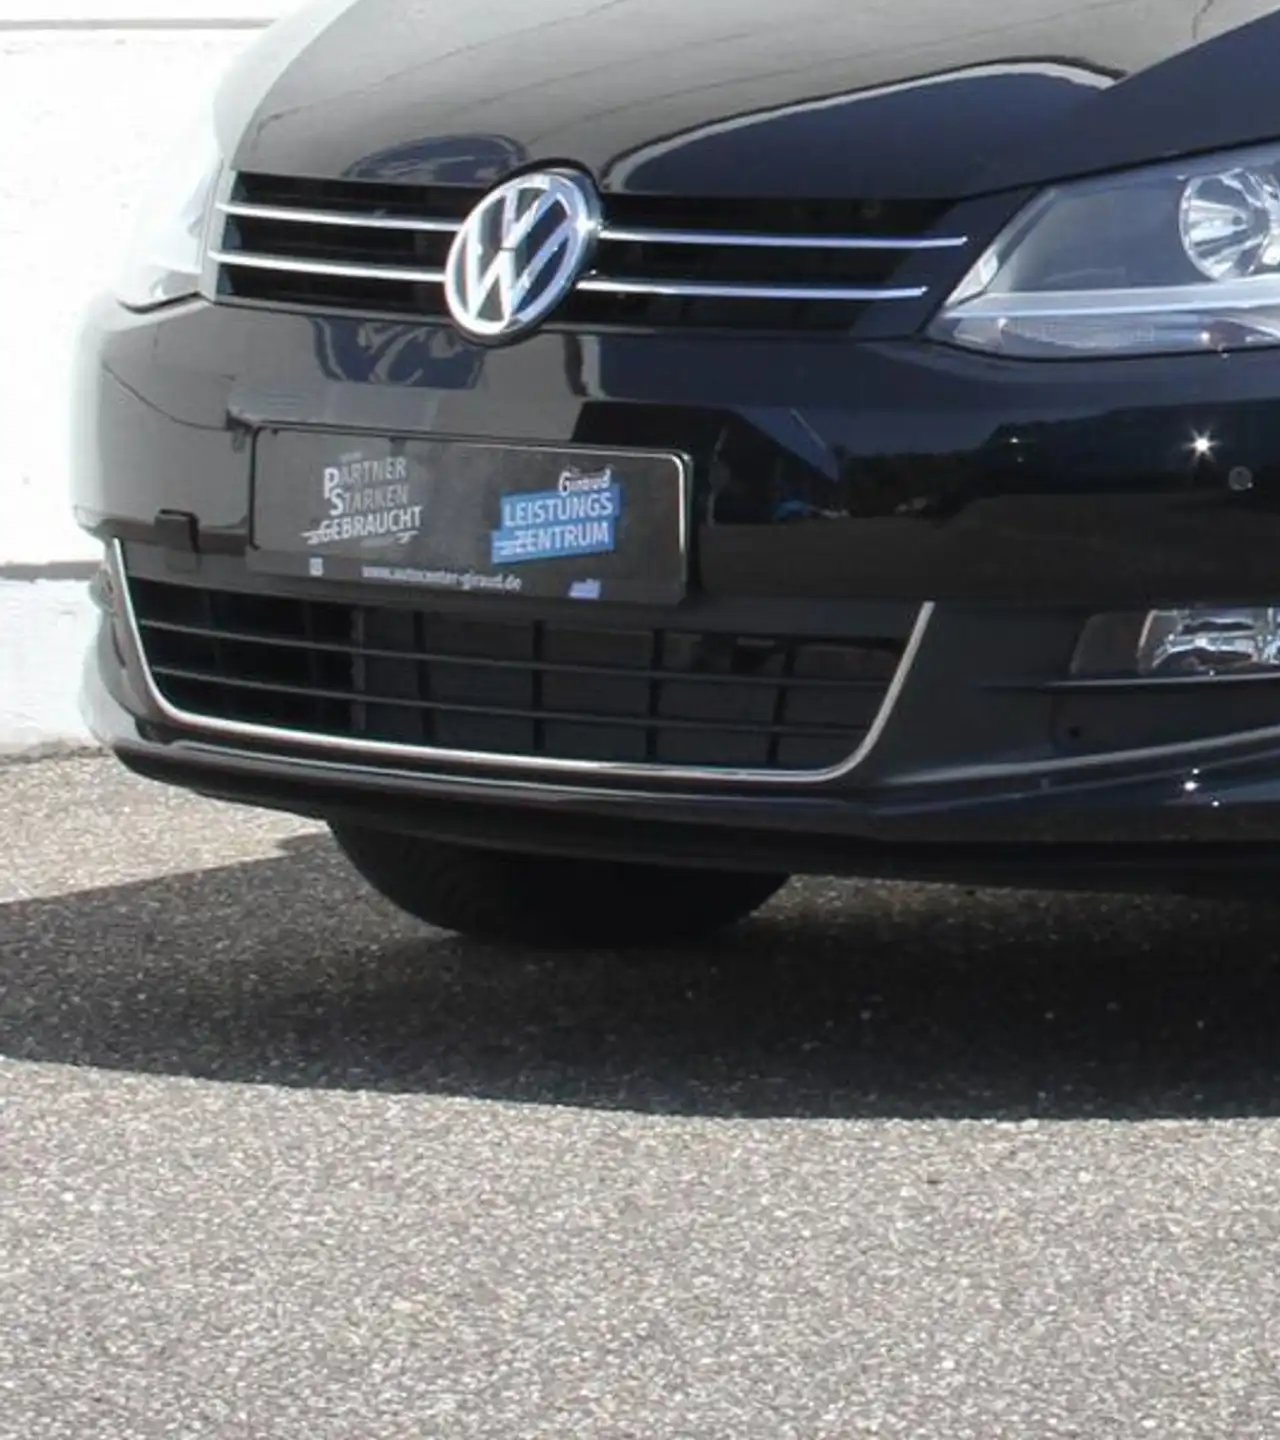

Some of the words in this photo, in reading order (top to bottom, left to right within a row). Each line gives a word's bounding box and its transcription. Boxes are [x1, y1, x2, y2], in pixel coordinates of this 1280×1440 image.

[323, 456, 407, 500] PARTNER
[319, 505, 422, 543] GEBRAUCHT
[503, 491, 613, 528] LEISTUNGS
[514, 520, 609, 553] ZENTRUM
